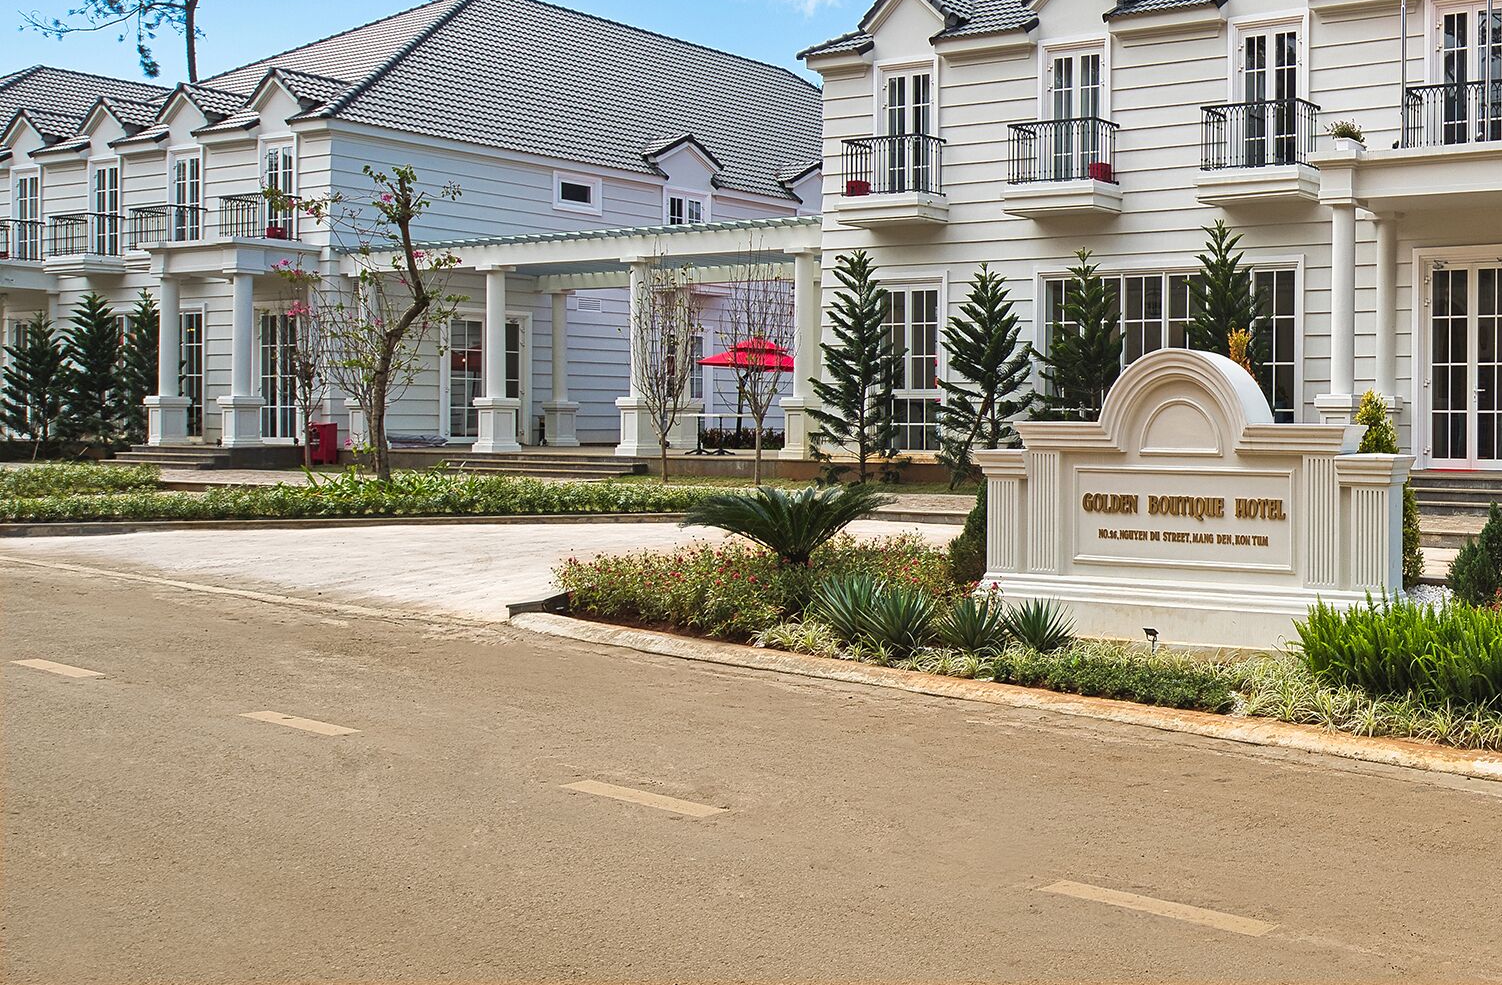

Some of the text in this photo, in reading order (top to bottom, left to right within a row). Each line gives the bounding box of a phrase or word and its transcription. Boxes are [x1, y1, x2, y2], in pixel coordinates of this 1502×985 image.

[1082, 492, 1287, 521] GOLDEN BOUTIQUE HOTEL
[1149, 530, 1160, 542] DU
[1252, 535, 1269, 547] TUM
